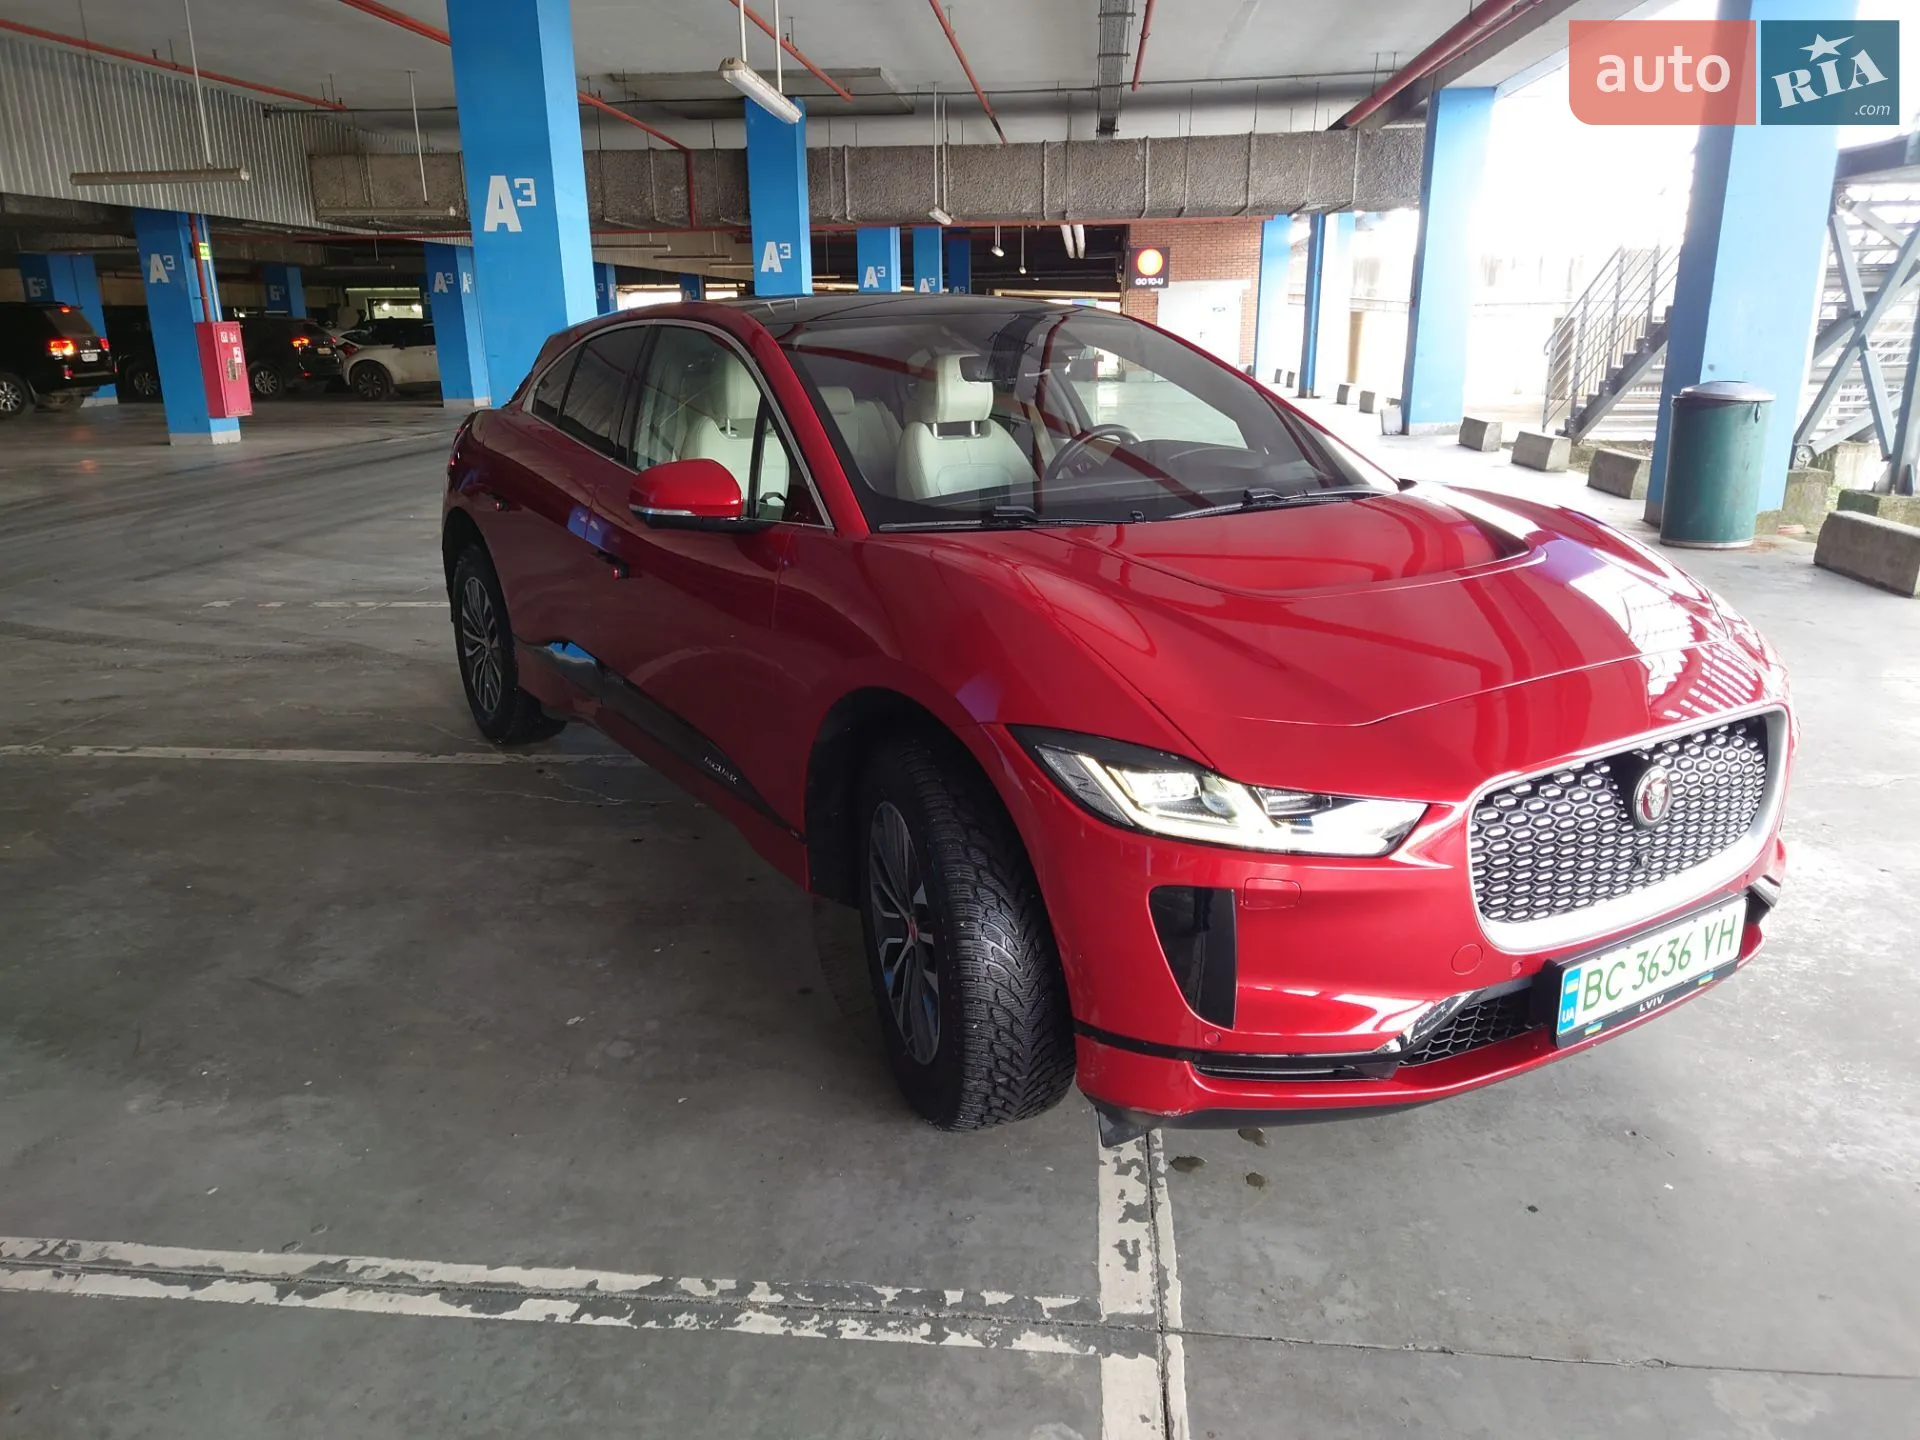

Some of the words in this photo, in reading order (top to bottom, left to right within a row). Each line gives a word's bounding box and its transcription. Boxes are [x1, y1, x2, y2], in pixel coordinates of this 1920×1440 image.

[1582, 961, 1626, 1012] BC
[1631, 931, 1694, 991] 3636
[1704, 914, 1737, 961] YH
[1639, 994, 1665, 1013] LVIV
